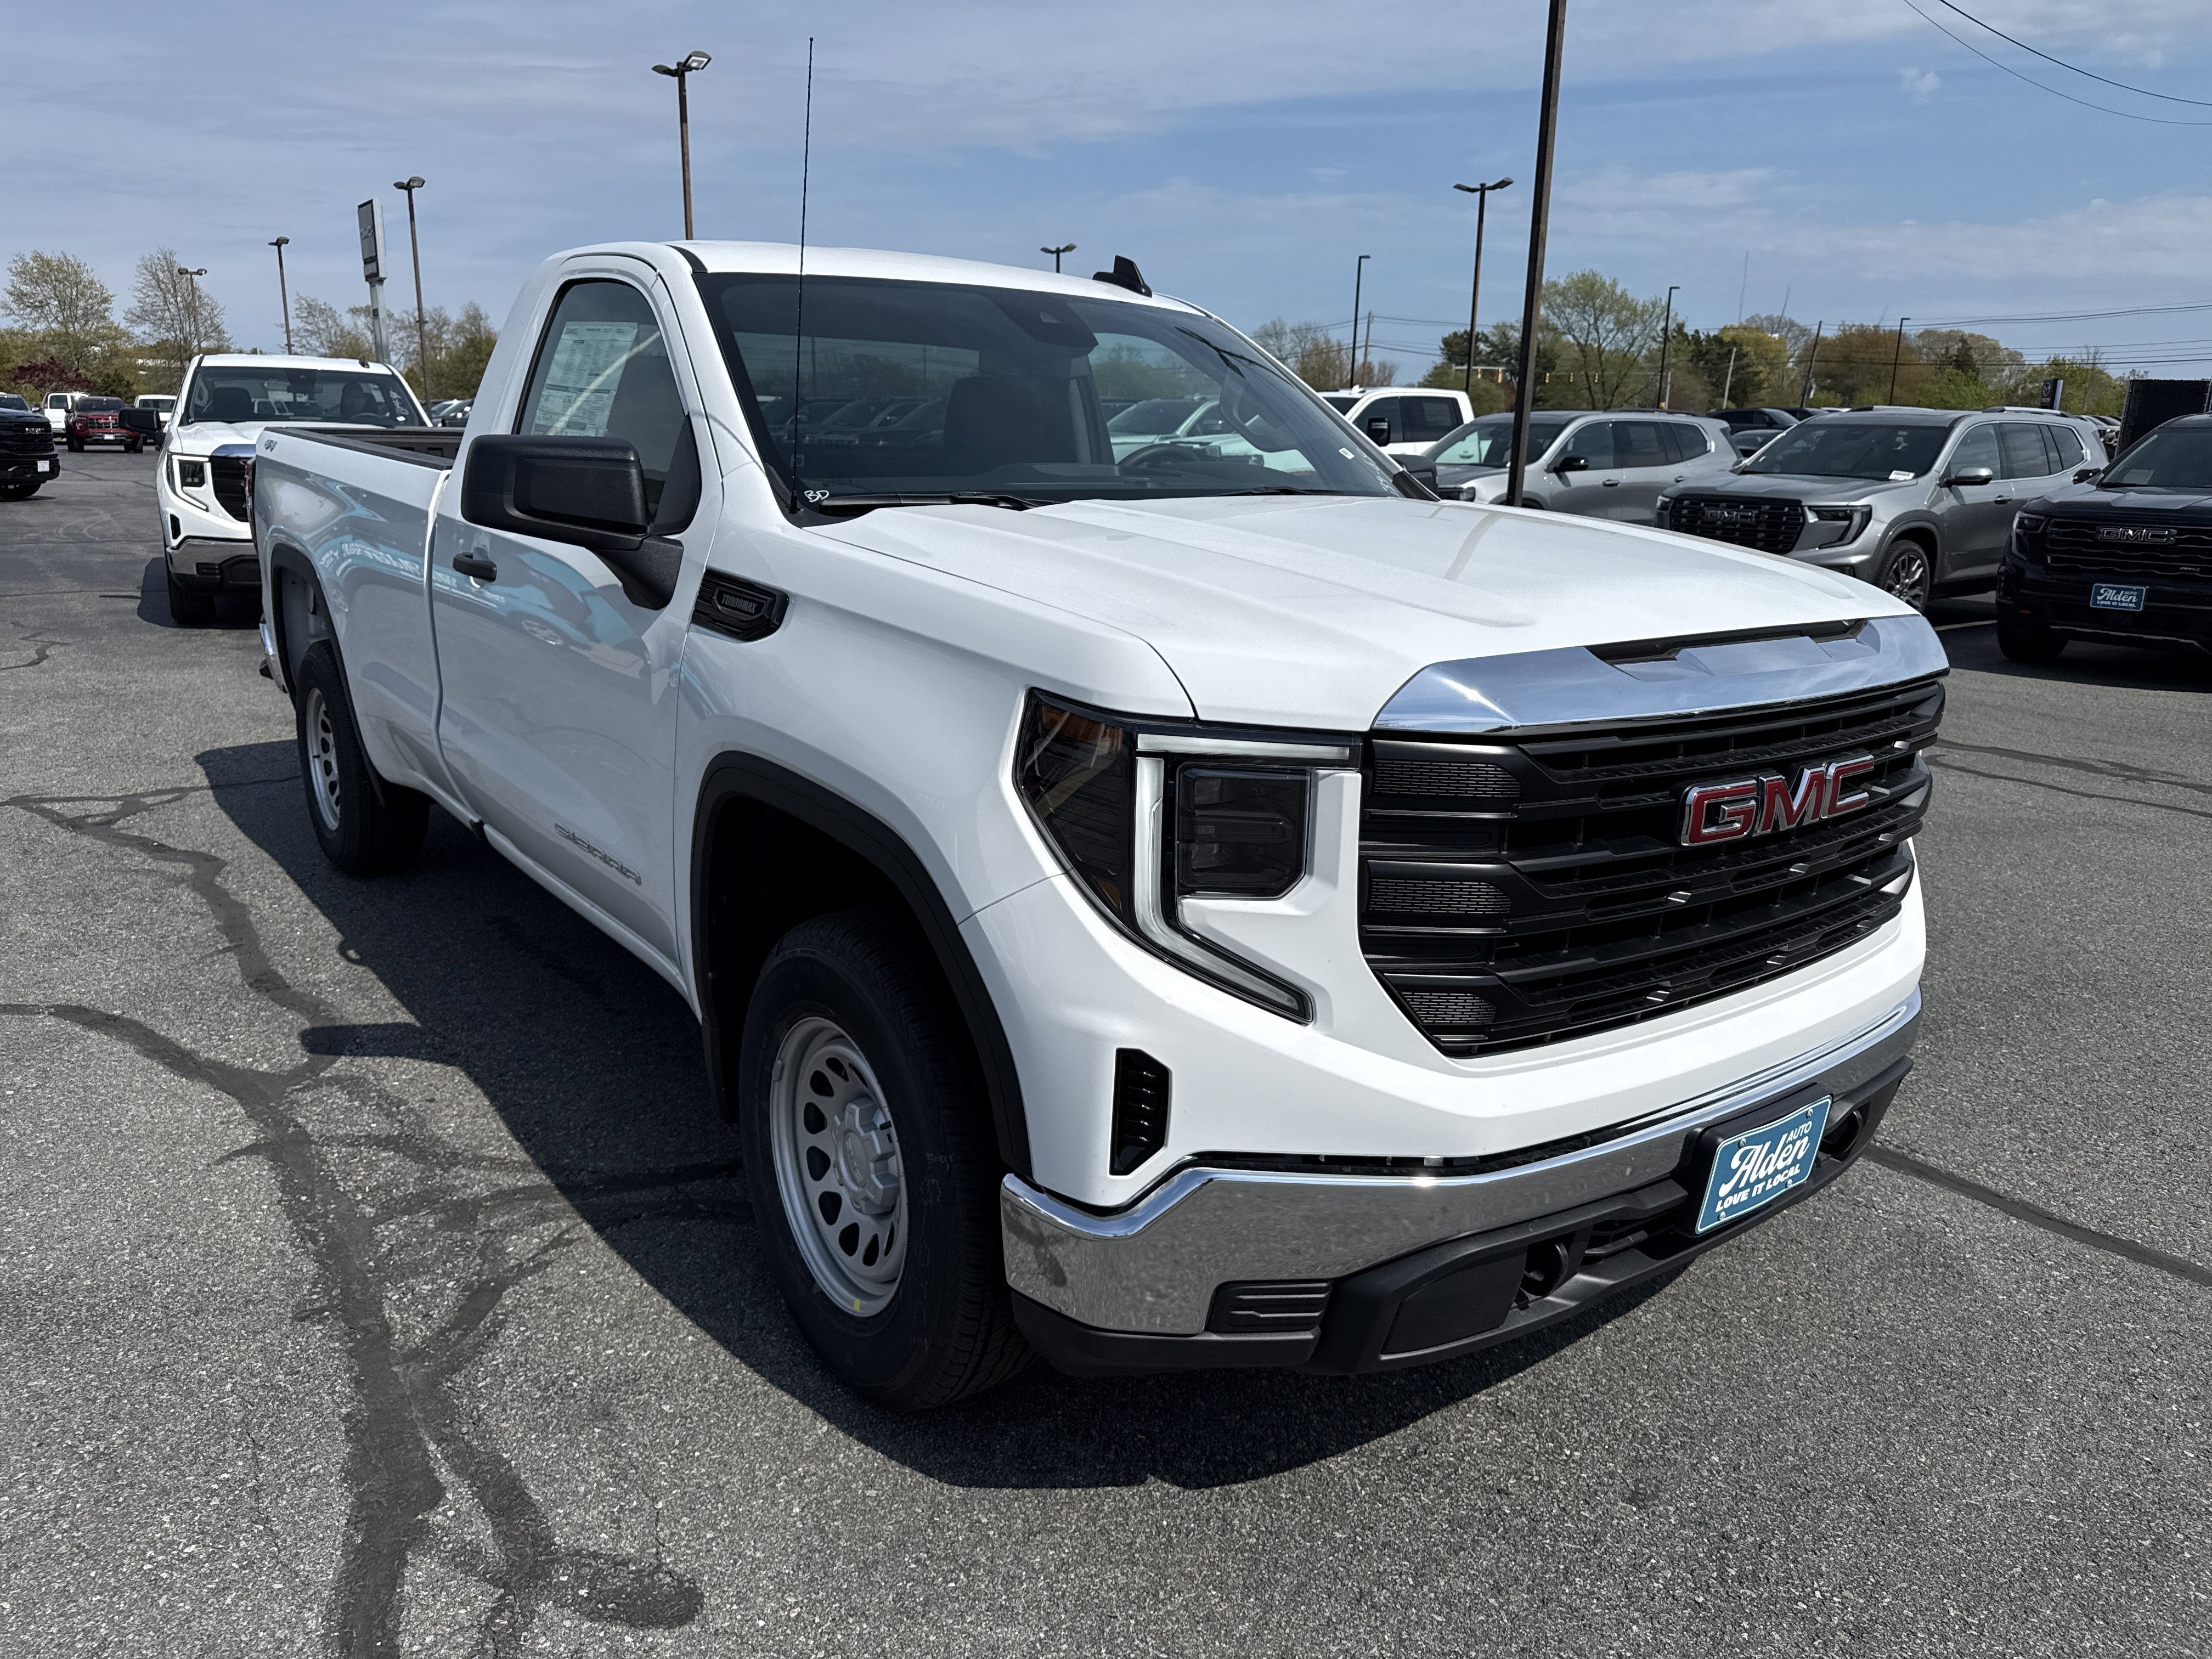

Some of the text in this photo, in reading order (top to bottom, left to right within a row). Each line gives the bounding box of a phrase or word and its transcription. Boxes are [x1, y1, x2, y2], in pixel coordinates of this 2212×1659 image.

[804, 490, 830, 503] BD
[2101, 527, 2169, 543] GMC
[2097, 588, 2138, 602] Alden
[1680, 755, 1875, 847] GMC
[1786, 1120, 1813, 1143] AUTO
[1718, 1133, 1810, 1198] Alden
[1715, 1163, 1801, 1213] LOVE IT LOCAL
